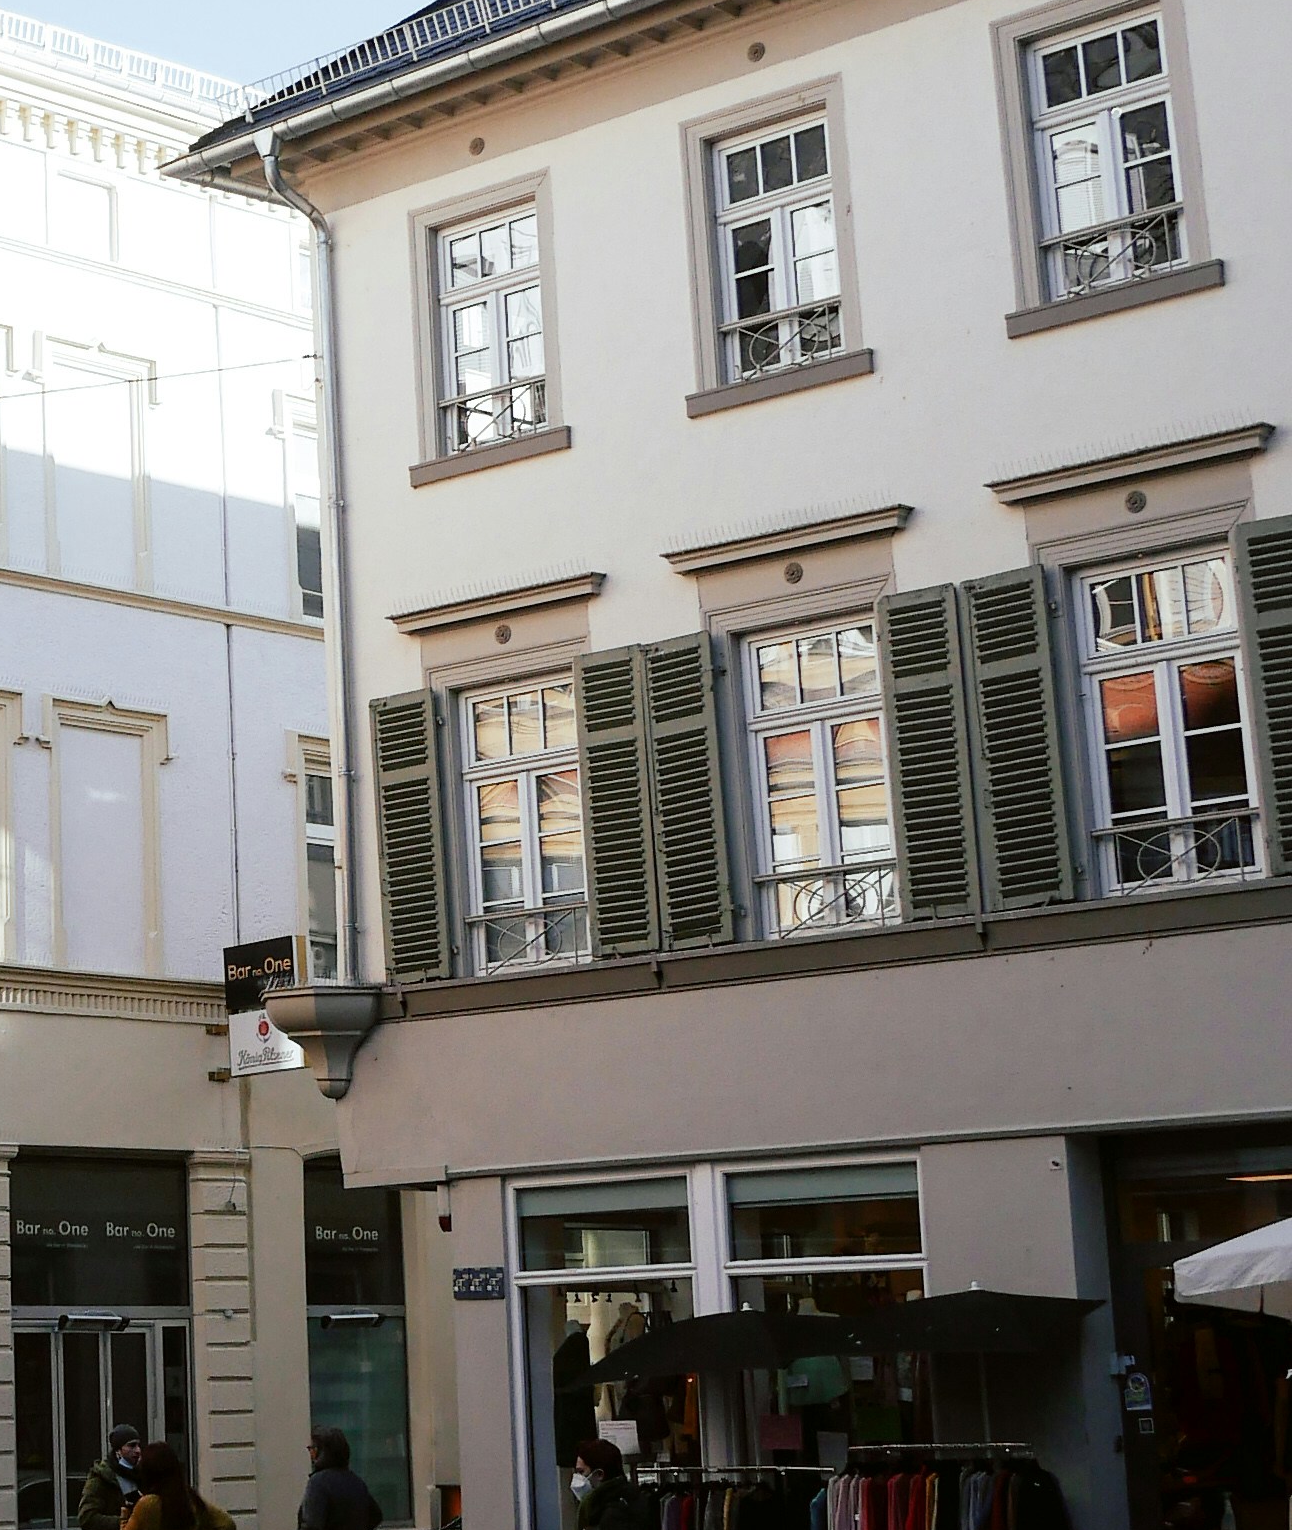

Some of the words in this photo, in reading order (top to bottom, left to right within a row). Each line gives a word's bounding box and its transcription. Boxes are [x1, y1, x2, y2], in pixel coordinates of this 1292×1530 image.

[227, 963, 251, 981] Bar
[263, 956, 292, 974] One
[16, 1220, 40, 1235] Bar
[58, 1220, 89, 1236] One
[106, 1222, 130, 1237] Bar
[147, 1222, 176, 1238] One
[315, 1225, 336, 1241] Bar
[352, 1226, 379, 1241] One
